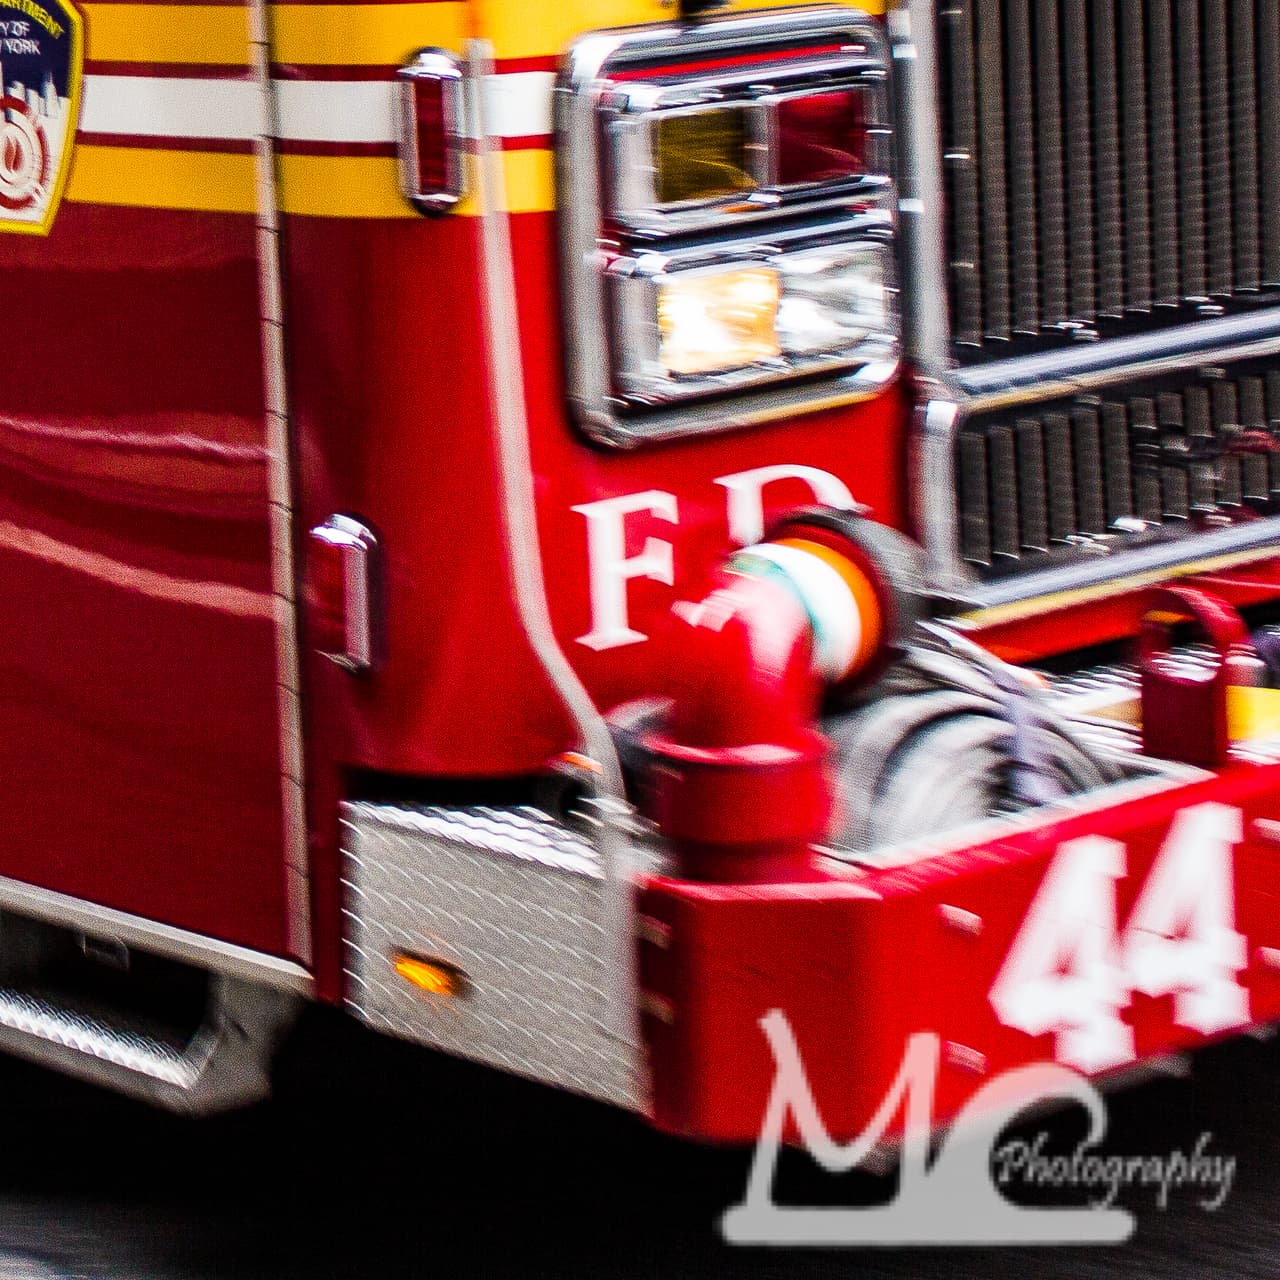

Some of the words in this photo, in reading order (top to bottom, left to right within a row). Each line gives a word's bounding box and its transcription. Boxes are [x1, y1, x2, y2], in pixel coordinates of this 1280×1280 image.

[10, 20, 30, 37] OF
[5, 38, 41, 56] YORK
[989, 802, 1251, 1076] 44
